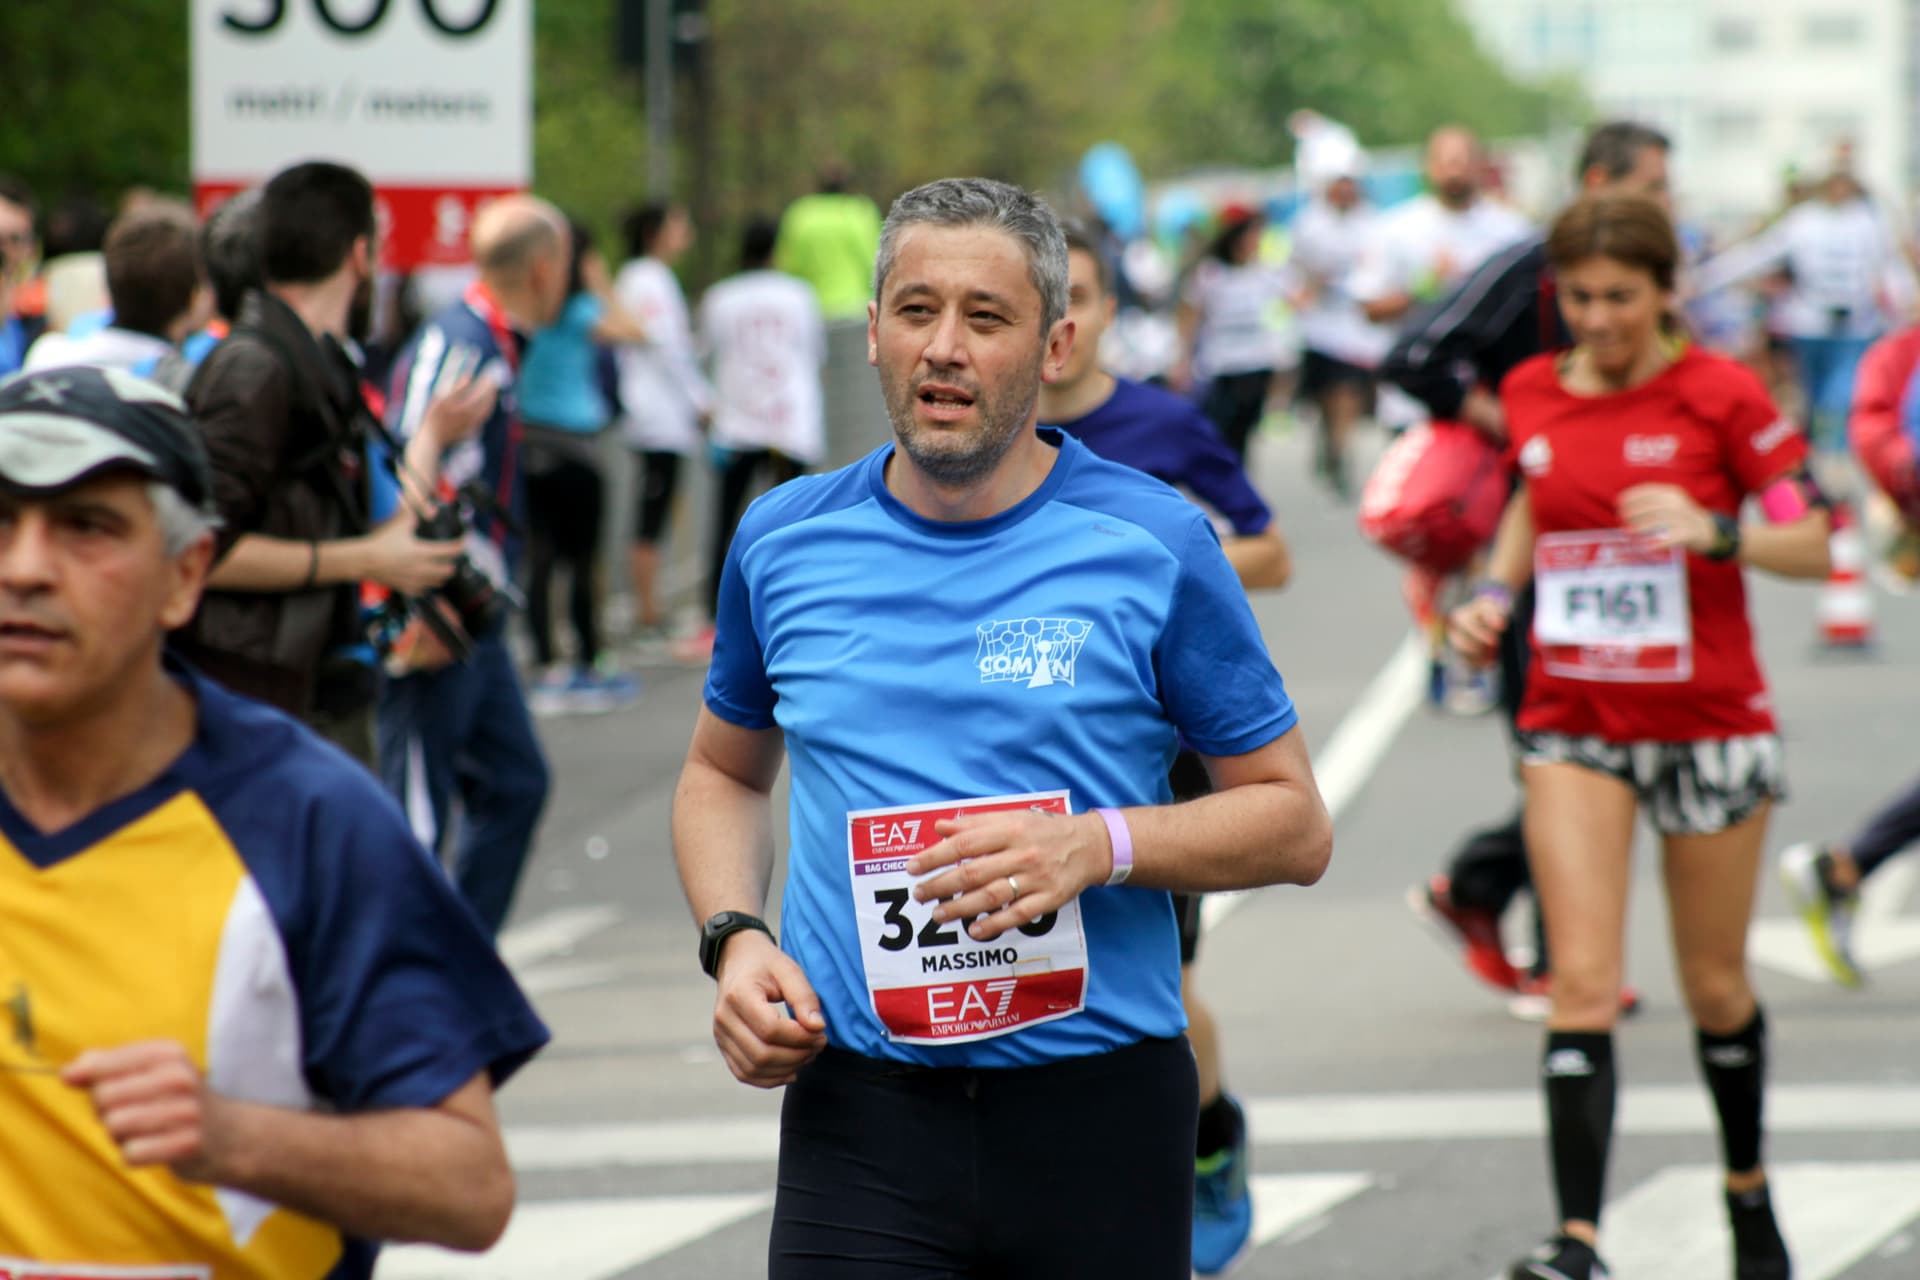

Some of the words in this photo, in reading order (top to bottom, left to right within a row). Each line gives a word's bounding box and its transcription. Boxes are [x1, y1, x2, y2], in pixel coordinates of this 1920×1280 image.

[1566, 583, 1658, 623] F161
[869, 819, 922, 847] EA7
[865, 863, 881, 873] BAG
[922, 947, 1018, 973] MASSIMO
[927, 979, 1018, 1023] EA7
[931, 1020, 976, 1036] EMPORIO
[986, 1012, 1020, 1029] ARMANI
